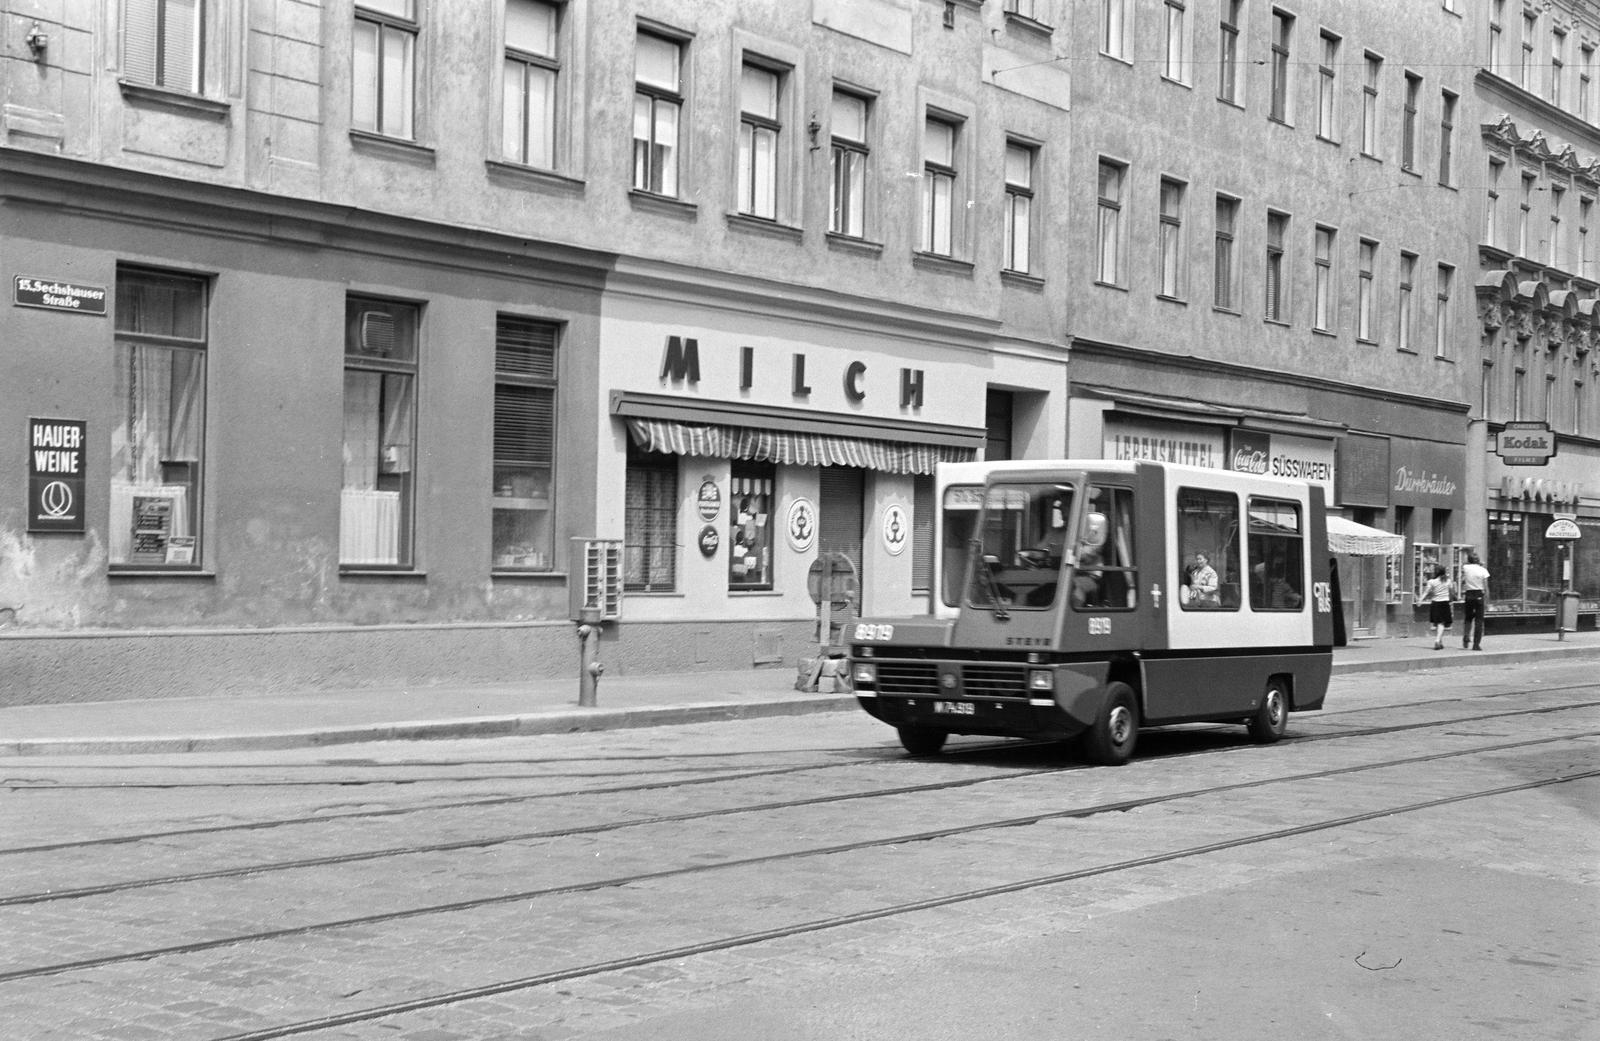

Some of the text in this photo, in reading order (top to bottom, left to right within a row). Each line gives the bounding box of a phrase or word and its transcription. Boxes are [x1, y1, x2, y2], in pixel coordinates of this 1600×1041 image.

[34, 281, 104, 300] Sechshauser
[43, 293, 80, 308] Straße
[659, 335, 925, 408] MILCH
[1115, 434, 1214, 469] LEBENSMITTEL
[1503, 436, 1548, 449] Kodak
[34, 450, 79, 473] WEINE
[1272, 454, 1331, 480] SÜSSWAREN
